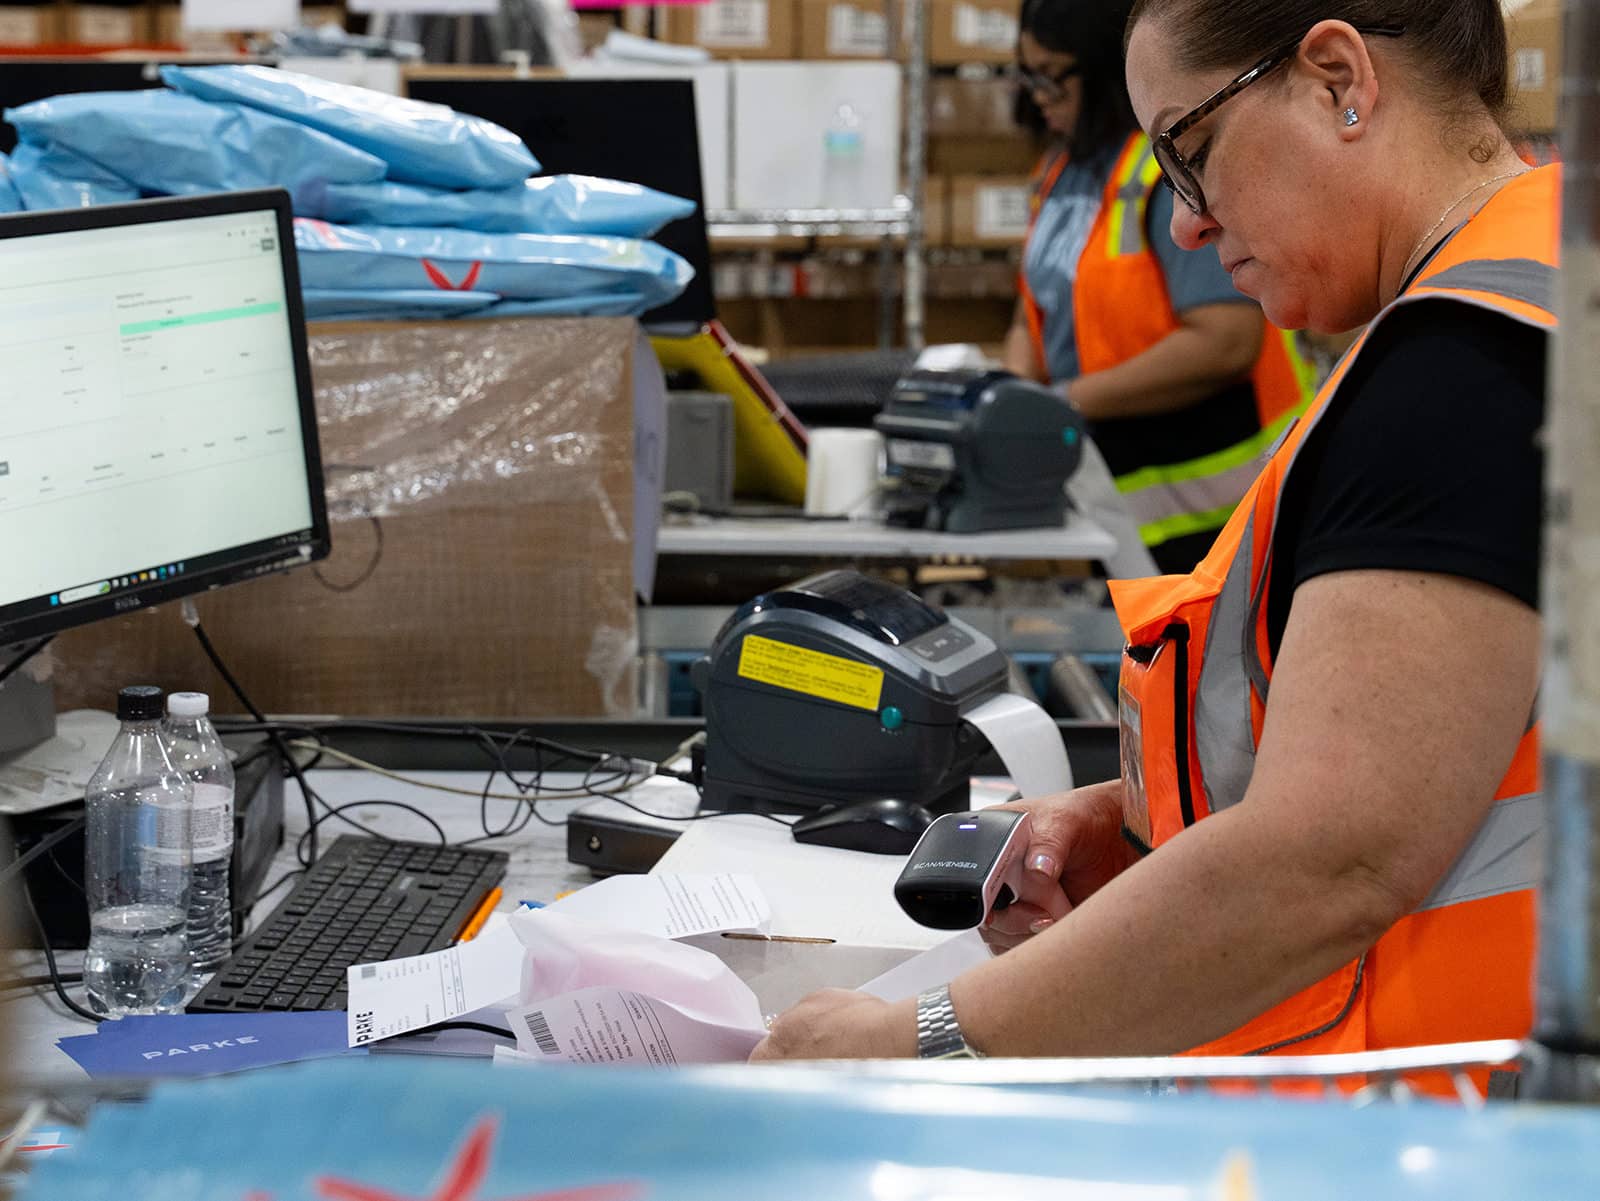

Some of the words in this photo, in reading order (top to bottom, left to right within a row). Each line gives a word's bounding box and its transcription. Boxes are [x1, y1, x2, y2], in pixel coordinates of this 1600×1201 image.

[913, 860, 978, 870] SCANAVENGER
[356, 1010, 374, 1043] PARKE
[142, 1036, 259, 1059] PARKE
